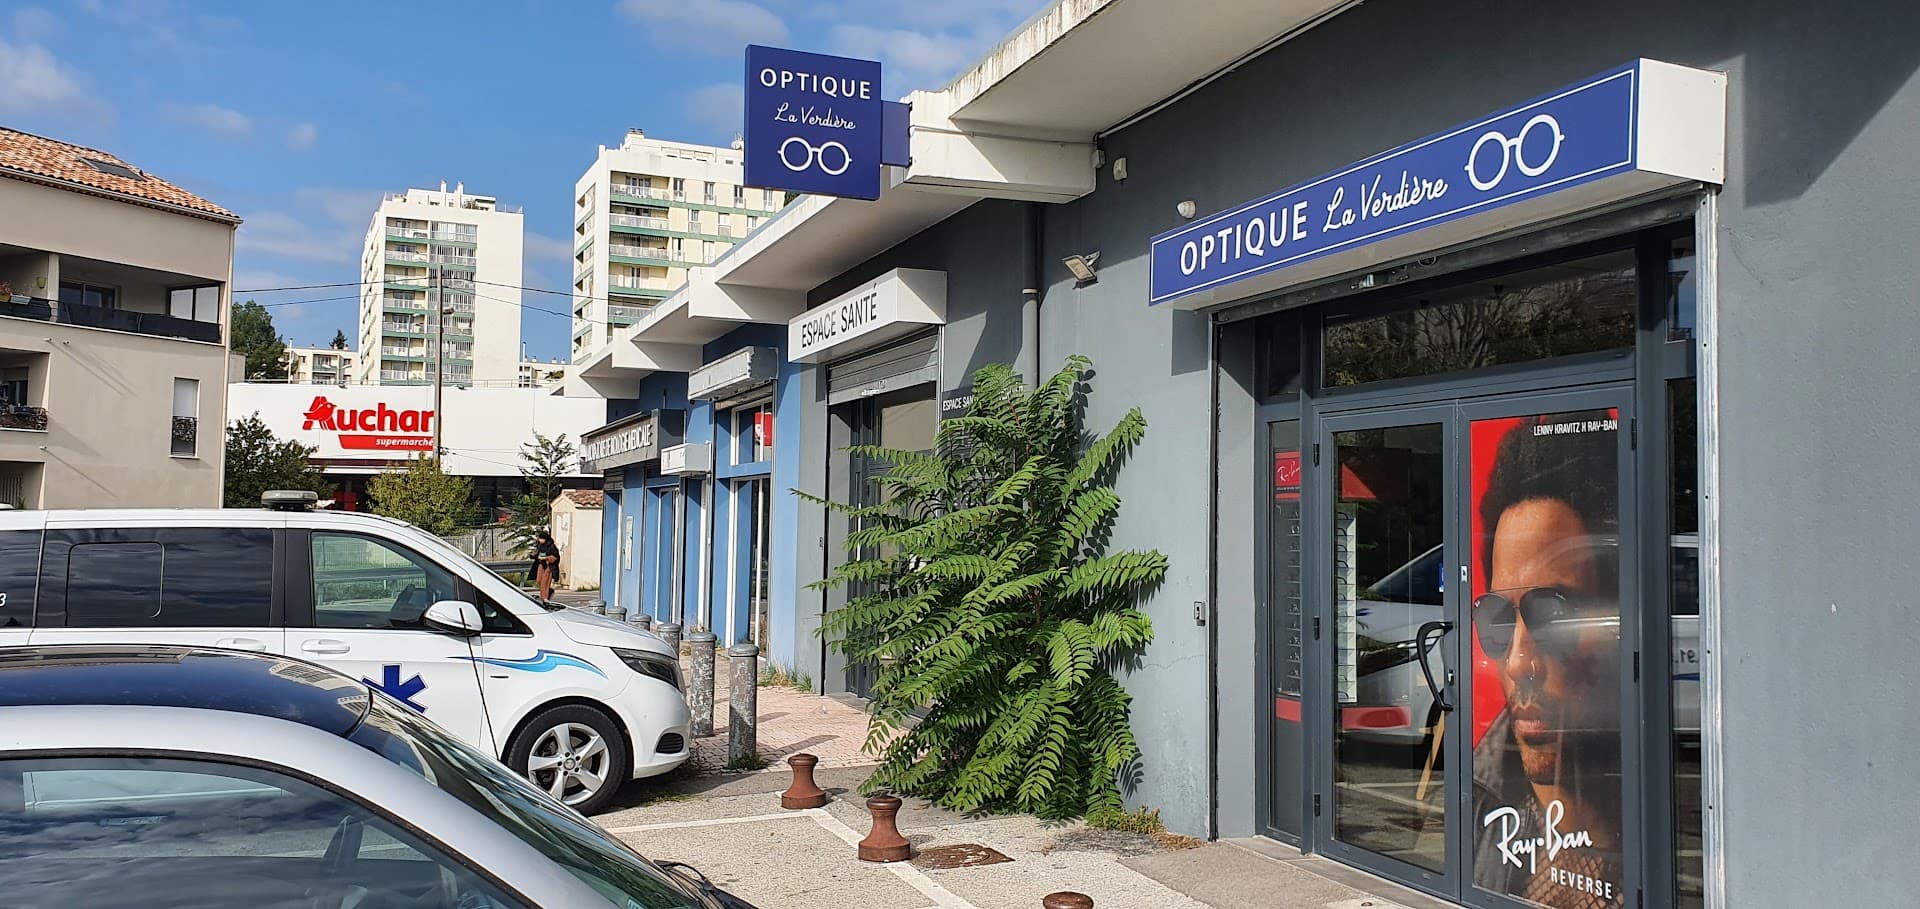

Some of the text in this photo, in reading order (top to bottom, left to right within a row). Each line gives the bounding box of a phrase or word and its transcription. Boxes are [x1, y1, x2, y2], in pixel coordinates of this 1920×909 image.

[760, 68, 871, 99] OPTIQUE
[774, 102, 856, 130] La Verdière
[1180, 170, 1449, 276] OPTIQUE La Verdière
[801, 283, 877, 348] ESPACE SANTÉ
[943, 397, 961, 411] ESPACE
[1533, 425, 1554, 436] LENNY
[1554, 422, 1580, 435] KRAVITZ
[1587, 419, 1618, 432] RAY-BAN
[1550, 866, 1613, 899] REVERSE
